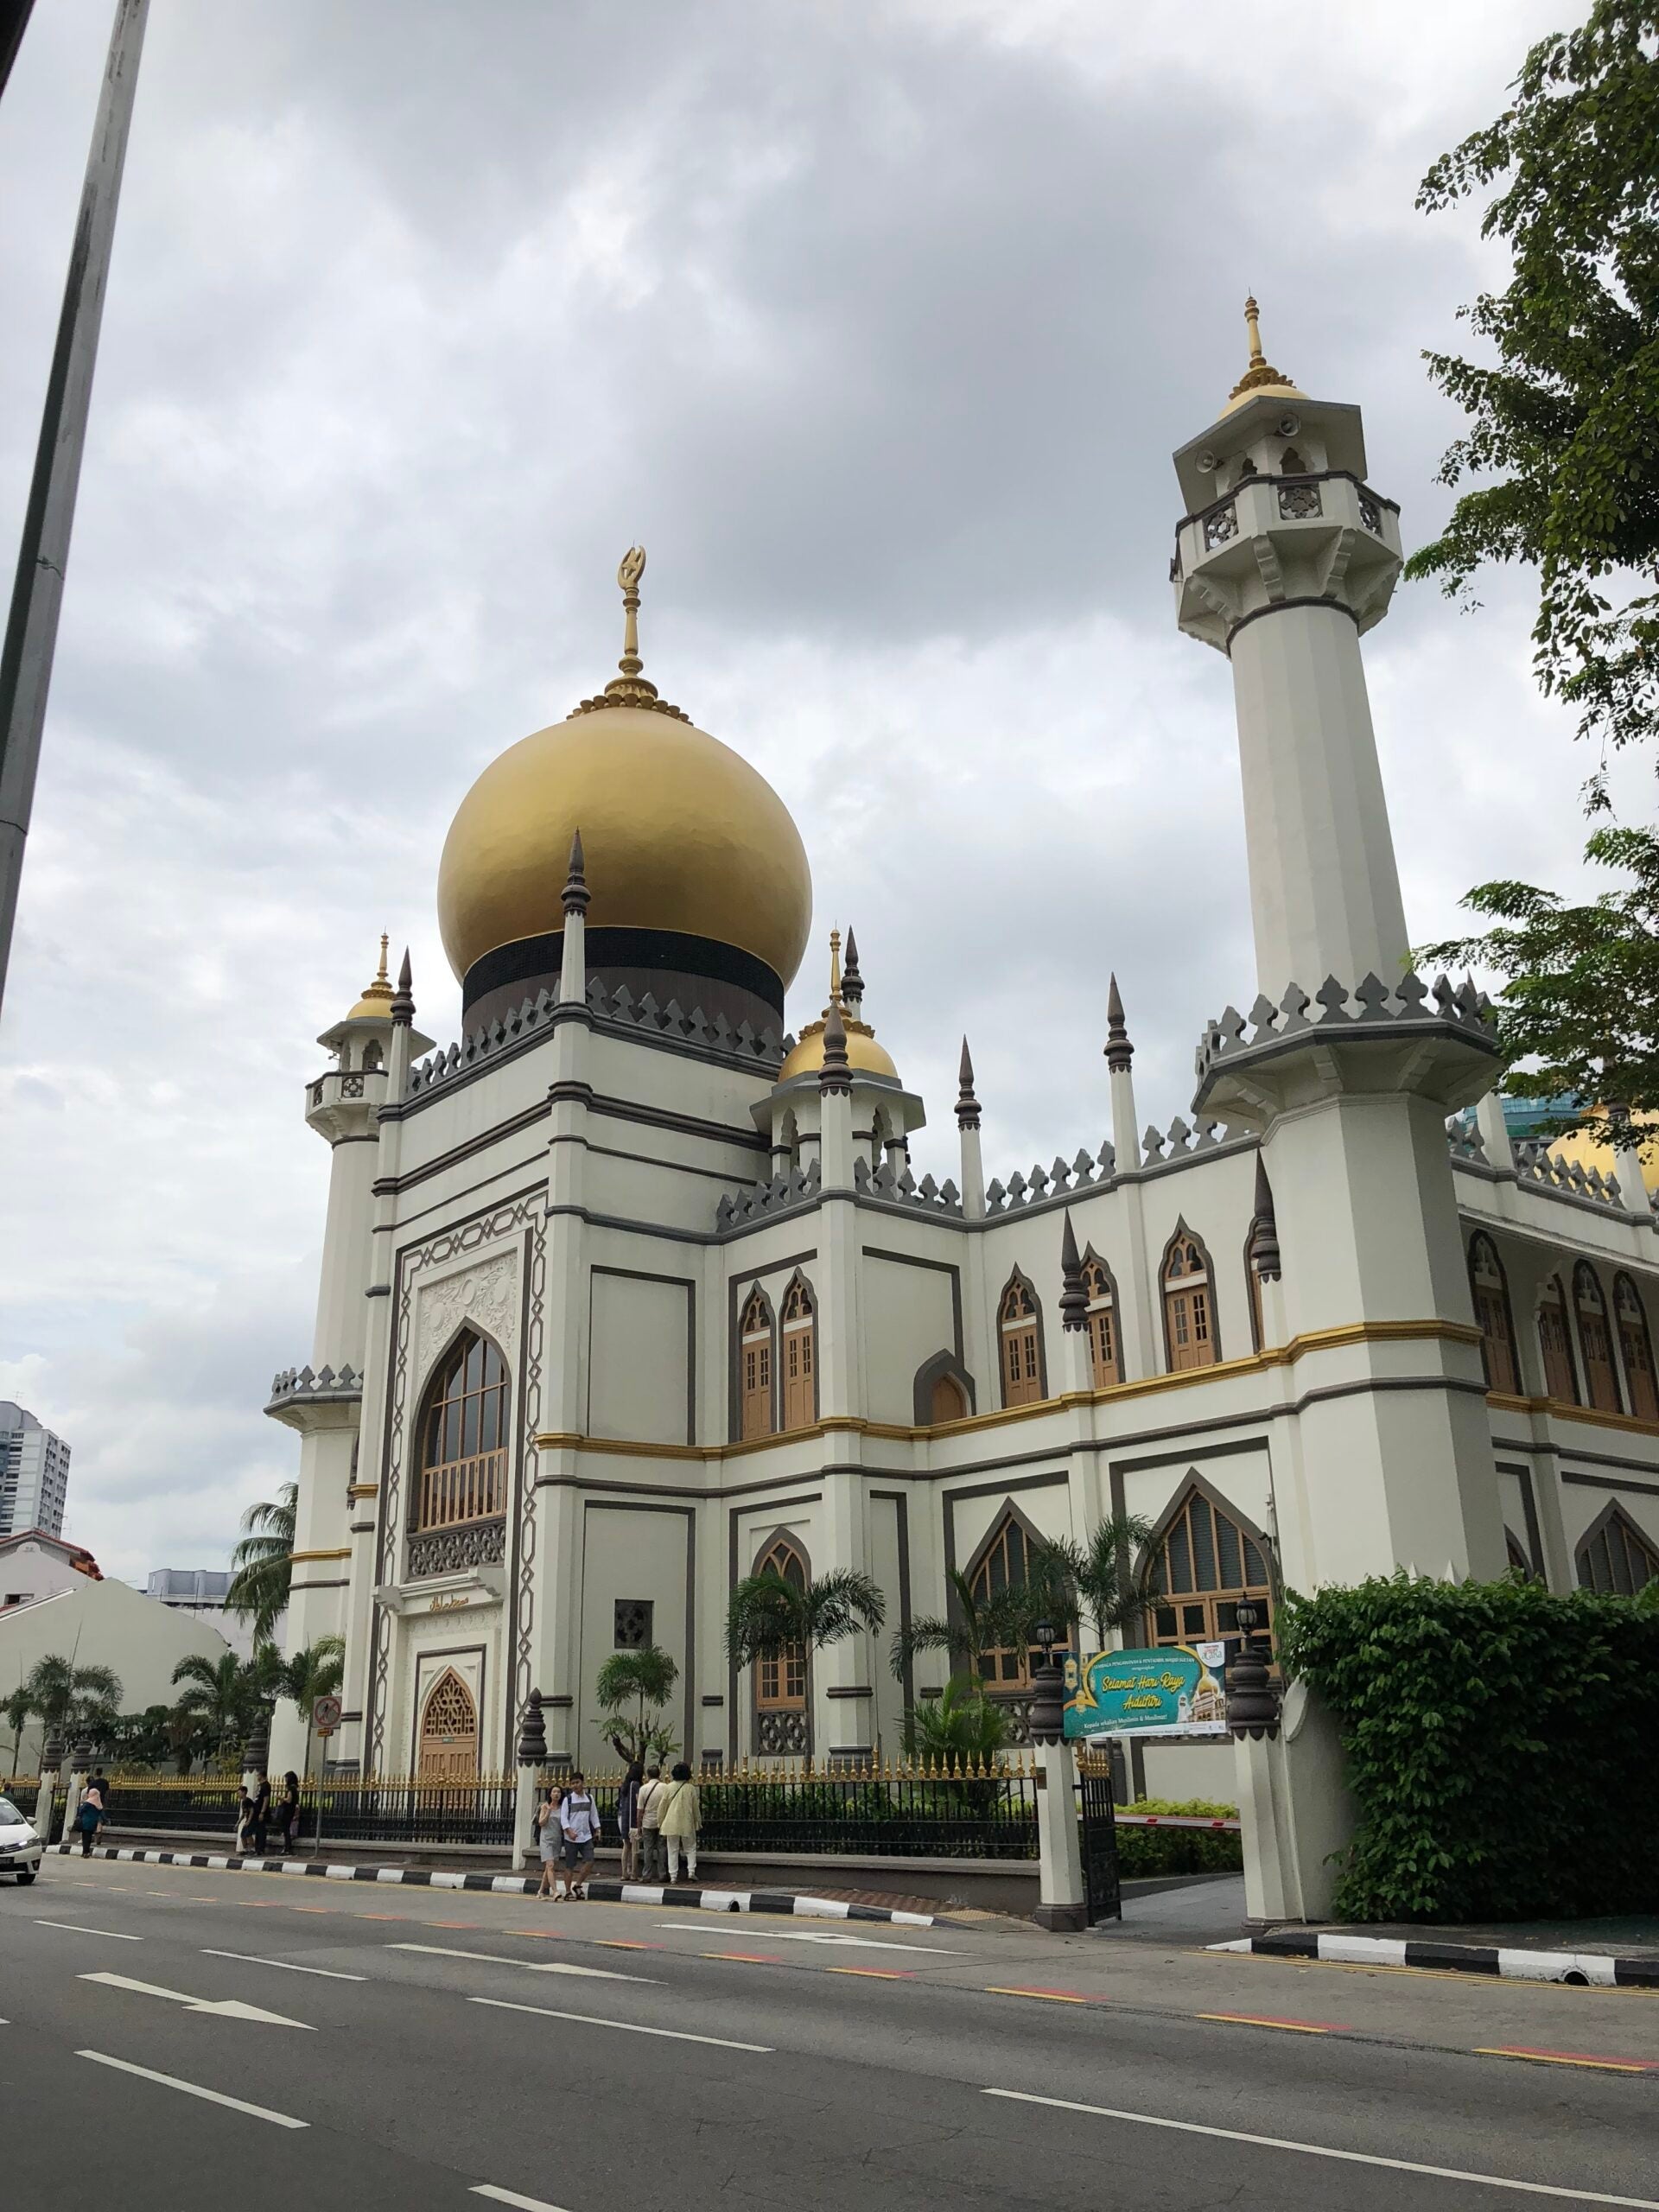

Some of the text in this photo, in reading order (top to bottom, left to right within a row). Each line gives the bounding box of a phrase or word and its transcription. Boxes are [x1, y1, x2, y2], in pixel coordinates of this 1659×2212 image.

[1102, 1671, 1185, 1694] Selamat Hari Raya
[1122, 1694, 1163, 1710] Aidilfitri
[1084, 1720, 1100, 1729] Kepada
[1117, 1716, 1139, 1725] Muslimin
